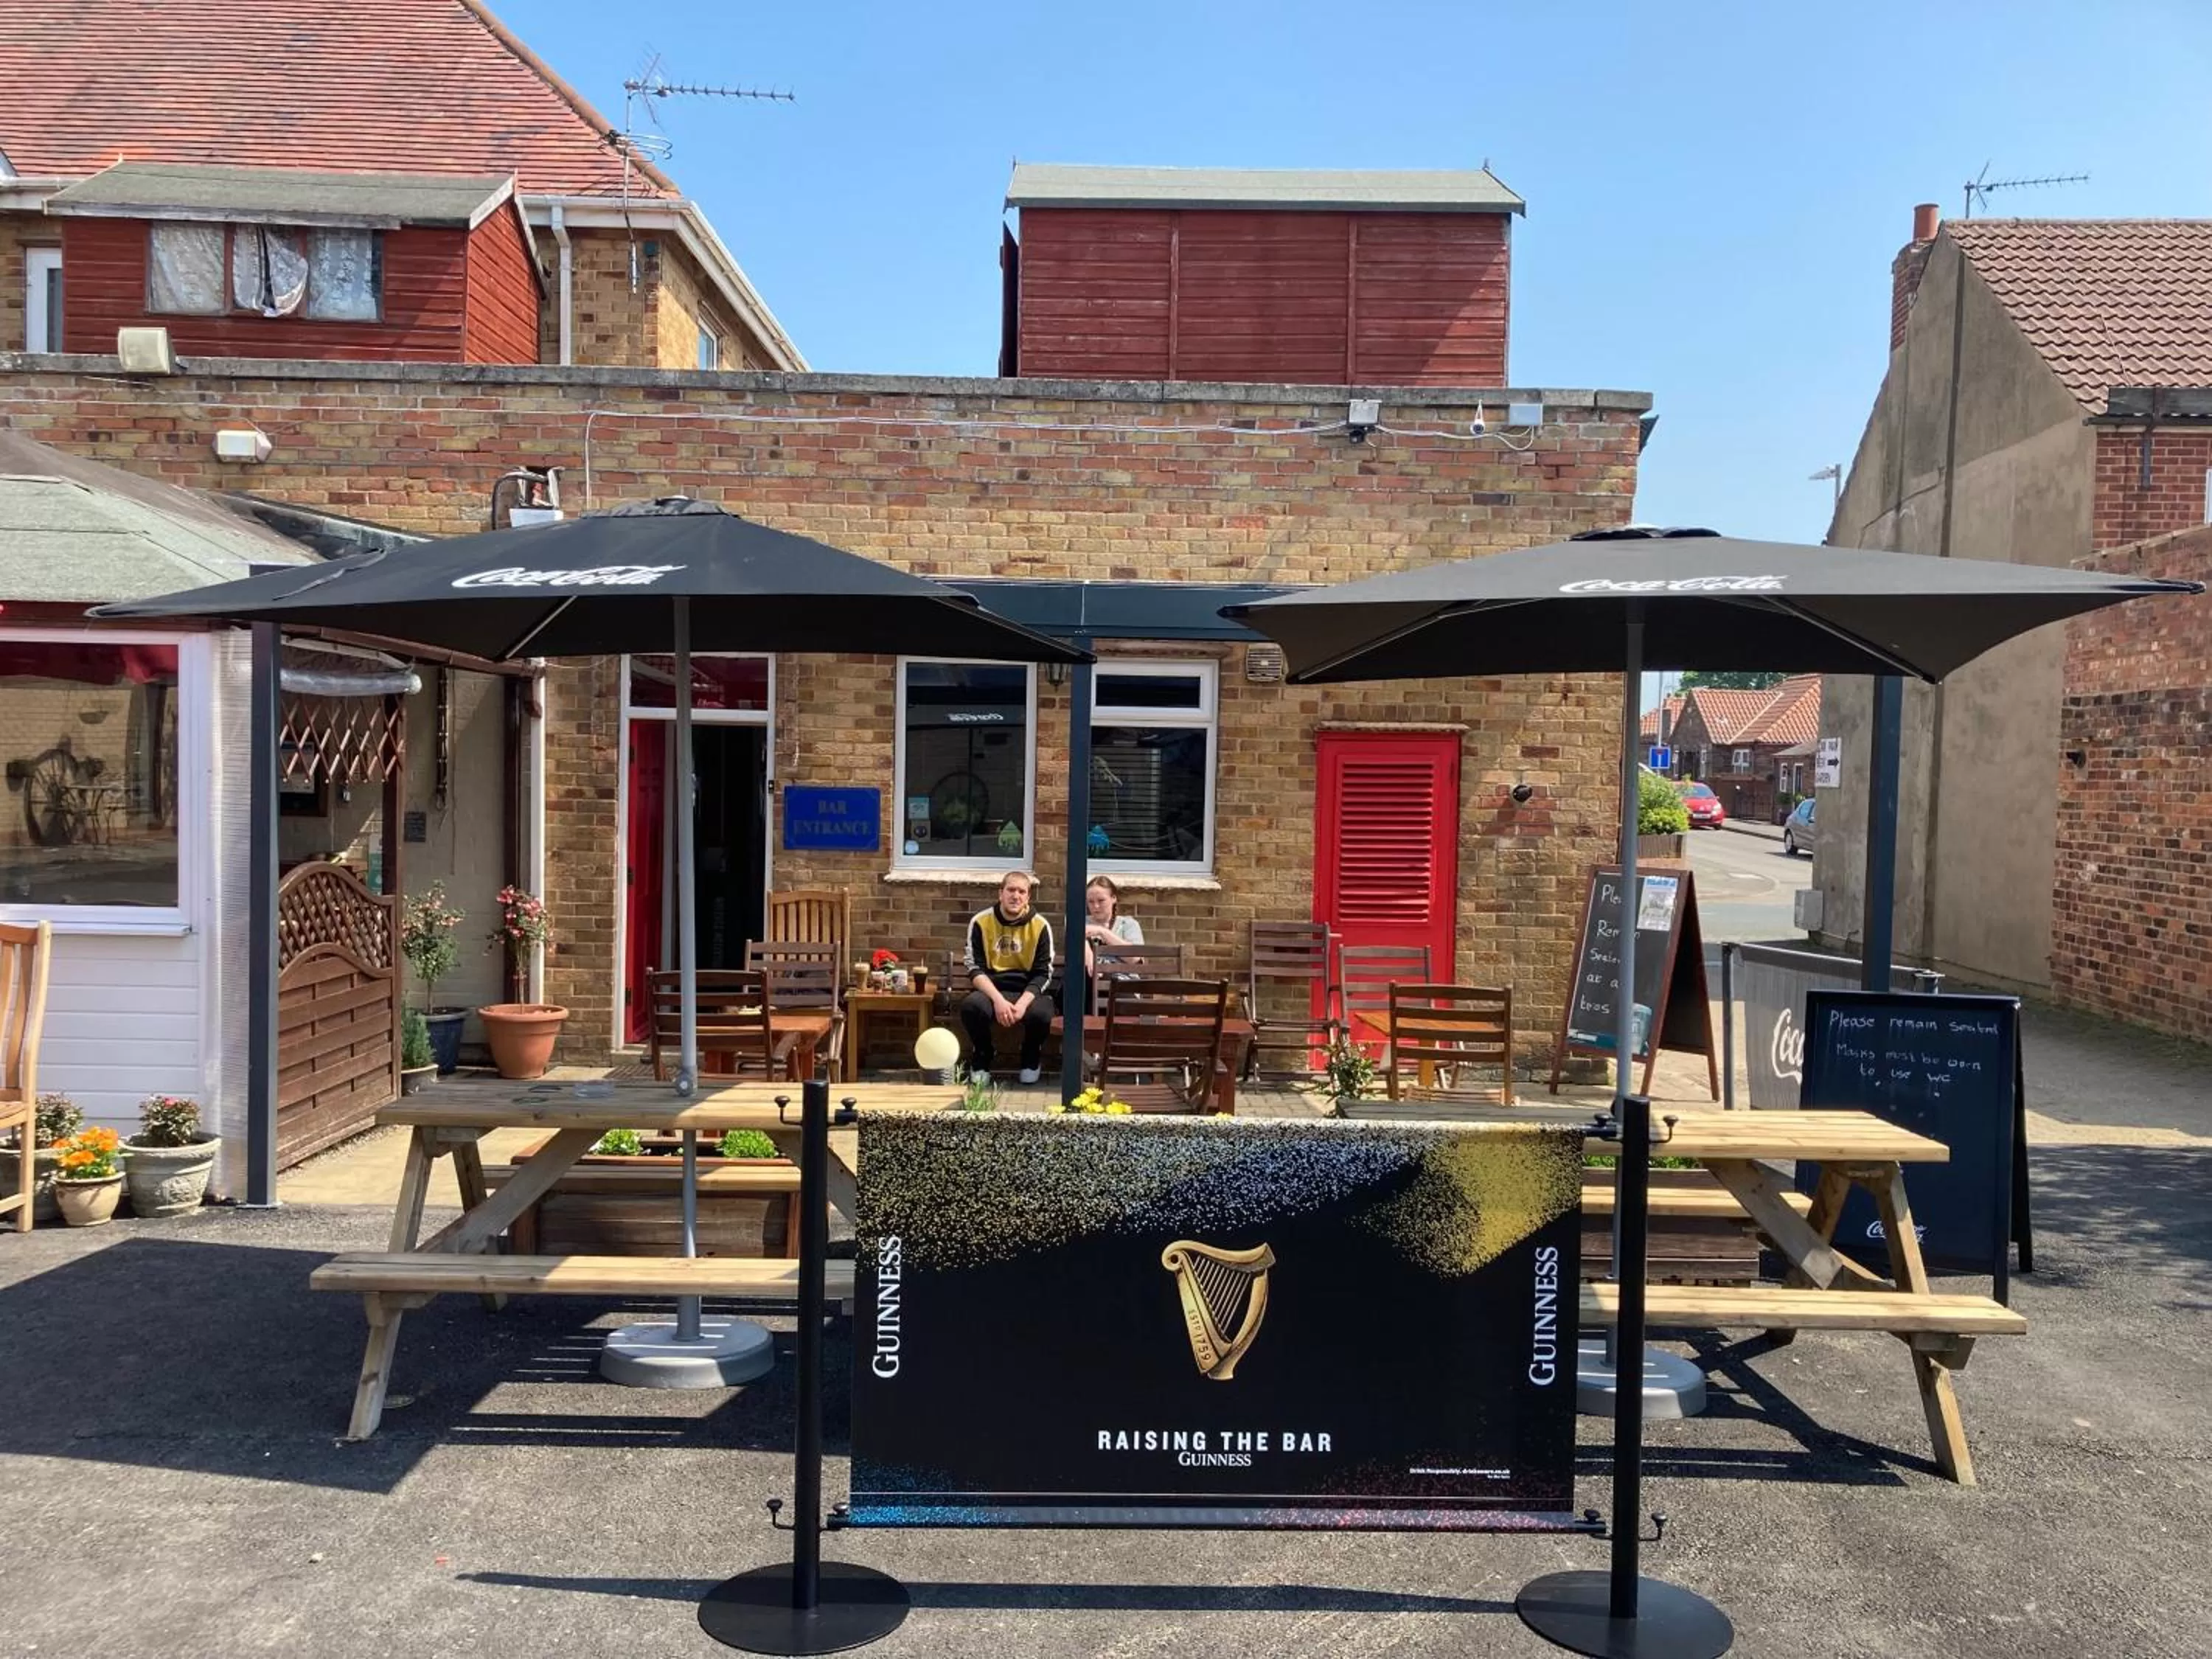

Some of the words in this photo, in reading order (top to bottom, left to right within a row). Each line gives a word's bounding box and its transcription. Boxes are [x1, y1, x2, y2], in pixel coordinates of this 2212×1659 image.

[452, 565, 687, 588] Coca-Cola
[1559, 575, 1790, 593] Coca-Cola
[818, 800, 847, 815] BAR
[793, 820, 869, 835] ENTRANCE
[1829, 1009, 1875, 1029] Please
[1889, 1018, 1938, 1031] remain
[1837, 1043, 1876, 1060] Masks
[1860, 1062, 1875, 1076] to
[1891, 1068, 1912, 1079] use
[1927, 1072, 1952, 1082] WC
[872, 1236, 902, 1378] GUINNESS
[1528, 1247, 1558, 1385] GUINNESS
[1194, 1332, 1211, 1361] 1759
[1098, 1430, 1206, 1450] RAISING
[1220, 1432, 1268, 1451] THE
[1283, 1433, 1332, 1452] BAR
[1178, 1451, 1251, 1467] GUINNESS
